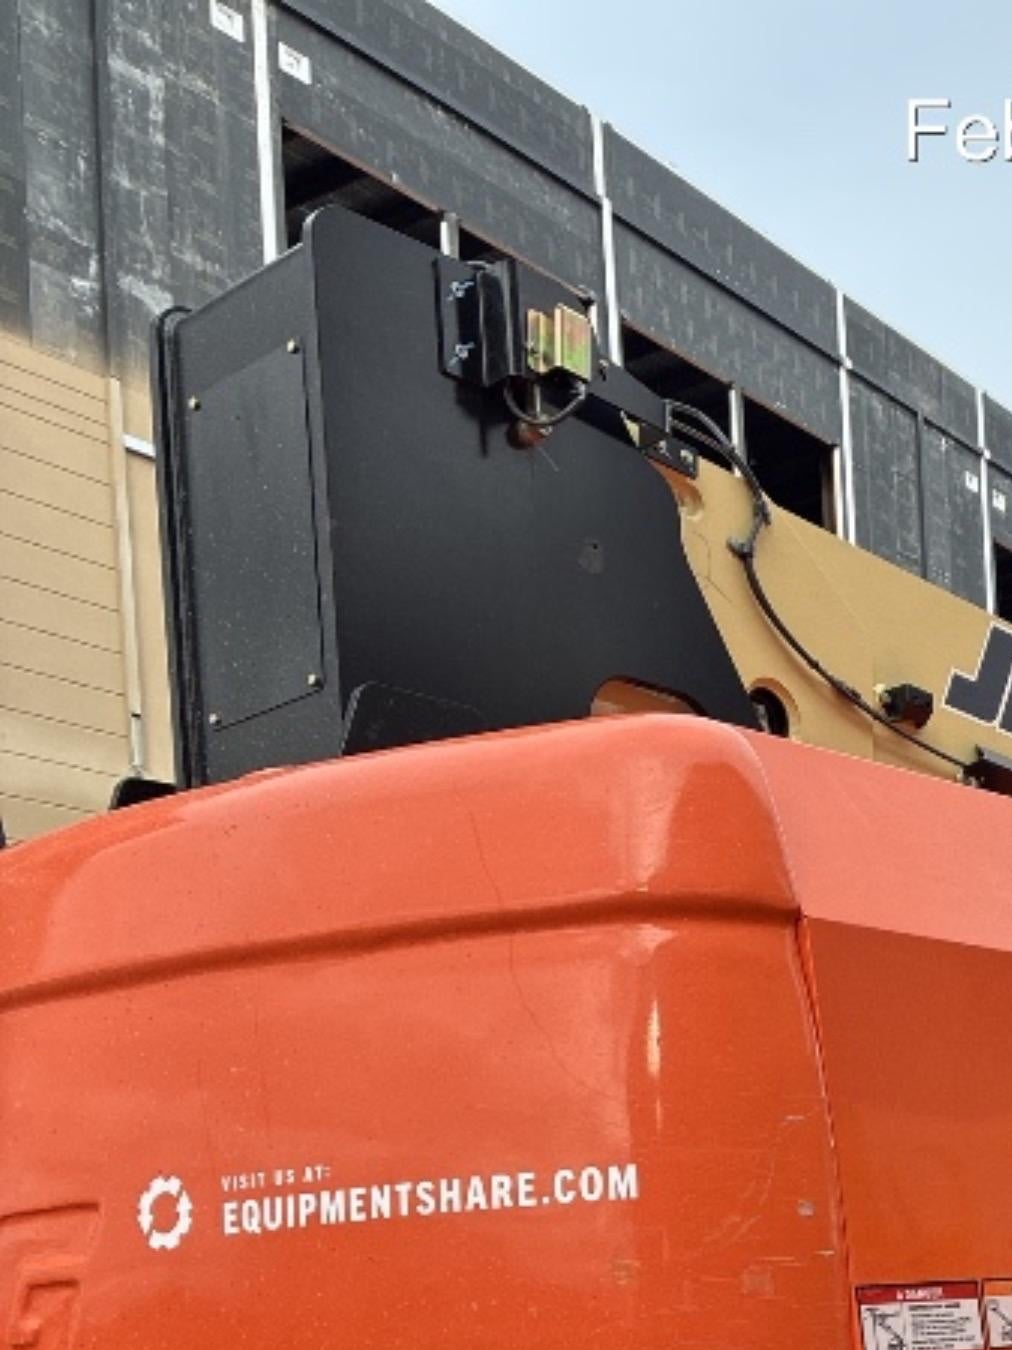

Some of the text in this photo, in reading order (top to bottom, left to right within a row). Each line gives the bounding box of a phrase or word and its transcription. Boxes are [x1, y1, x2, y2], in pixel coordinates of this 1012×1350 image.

[221, 1163, 331, 1193] VISIT US AT:
[222, 1163, 639, 1236] EQUIPMENTSHARE.COM
